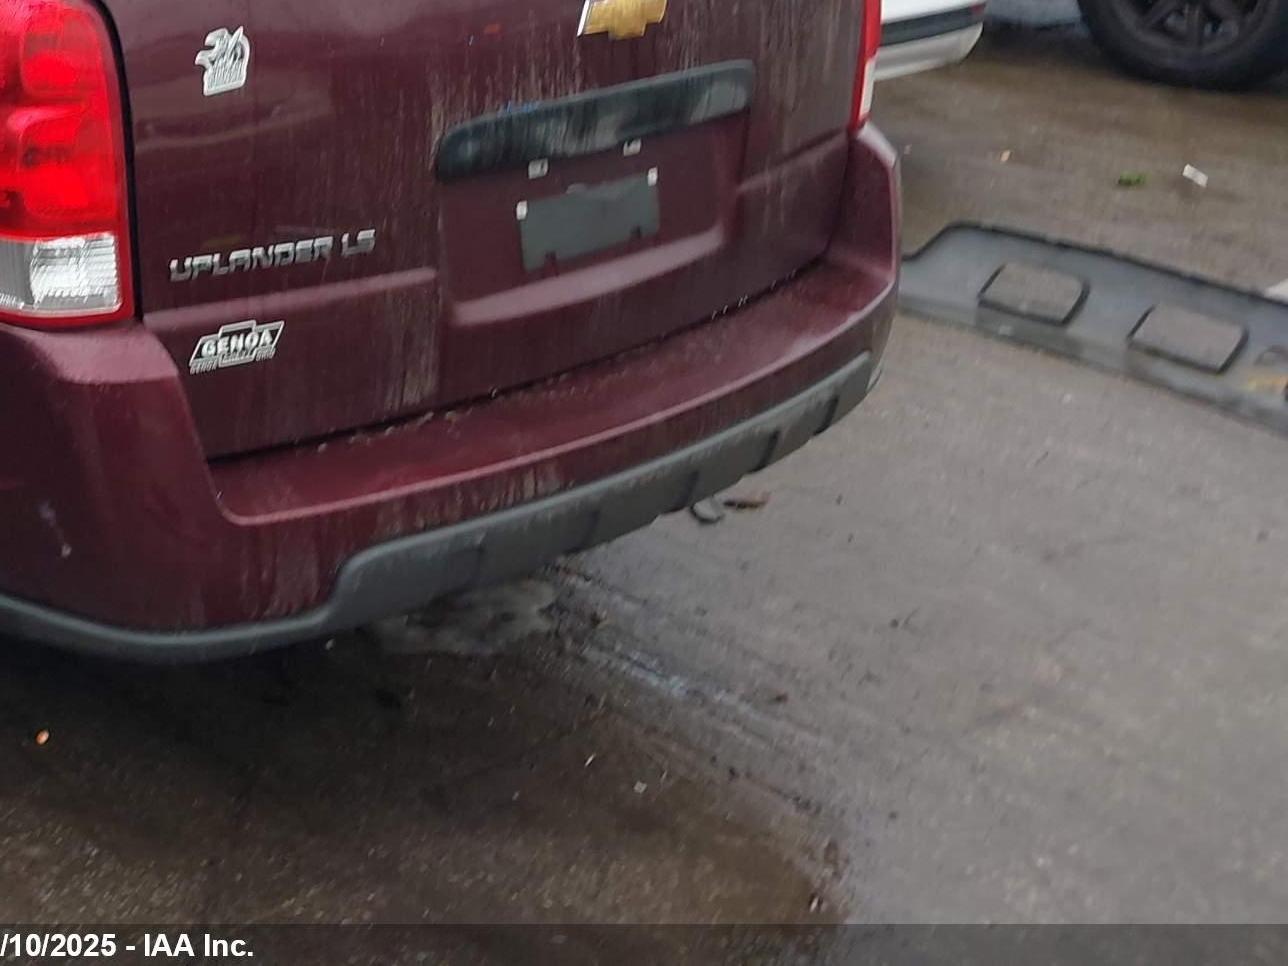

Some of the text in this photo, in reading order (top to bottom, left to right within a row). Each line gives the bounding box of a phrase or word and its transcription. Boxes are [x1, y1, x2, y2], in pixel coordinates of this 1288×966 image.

[169, 228, 376, 282] UPLANDER LS
[201, 328, 273, 357] GENOA
